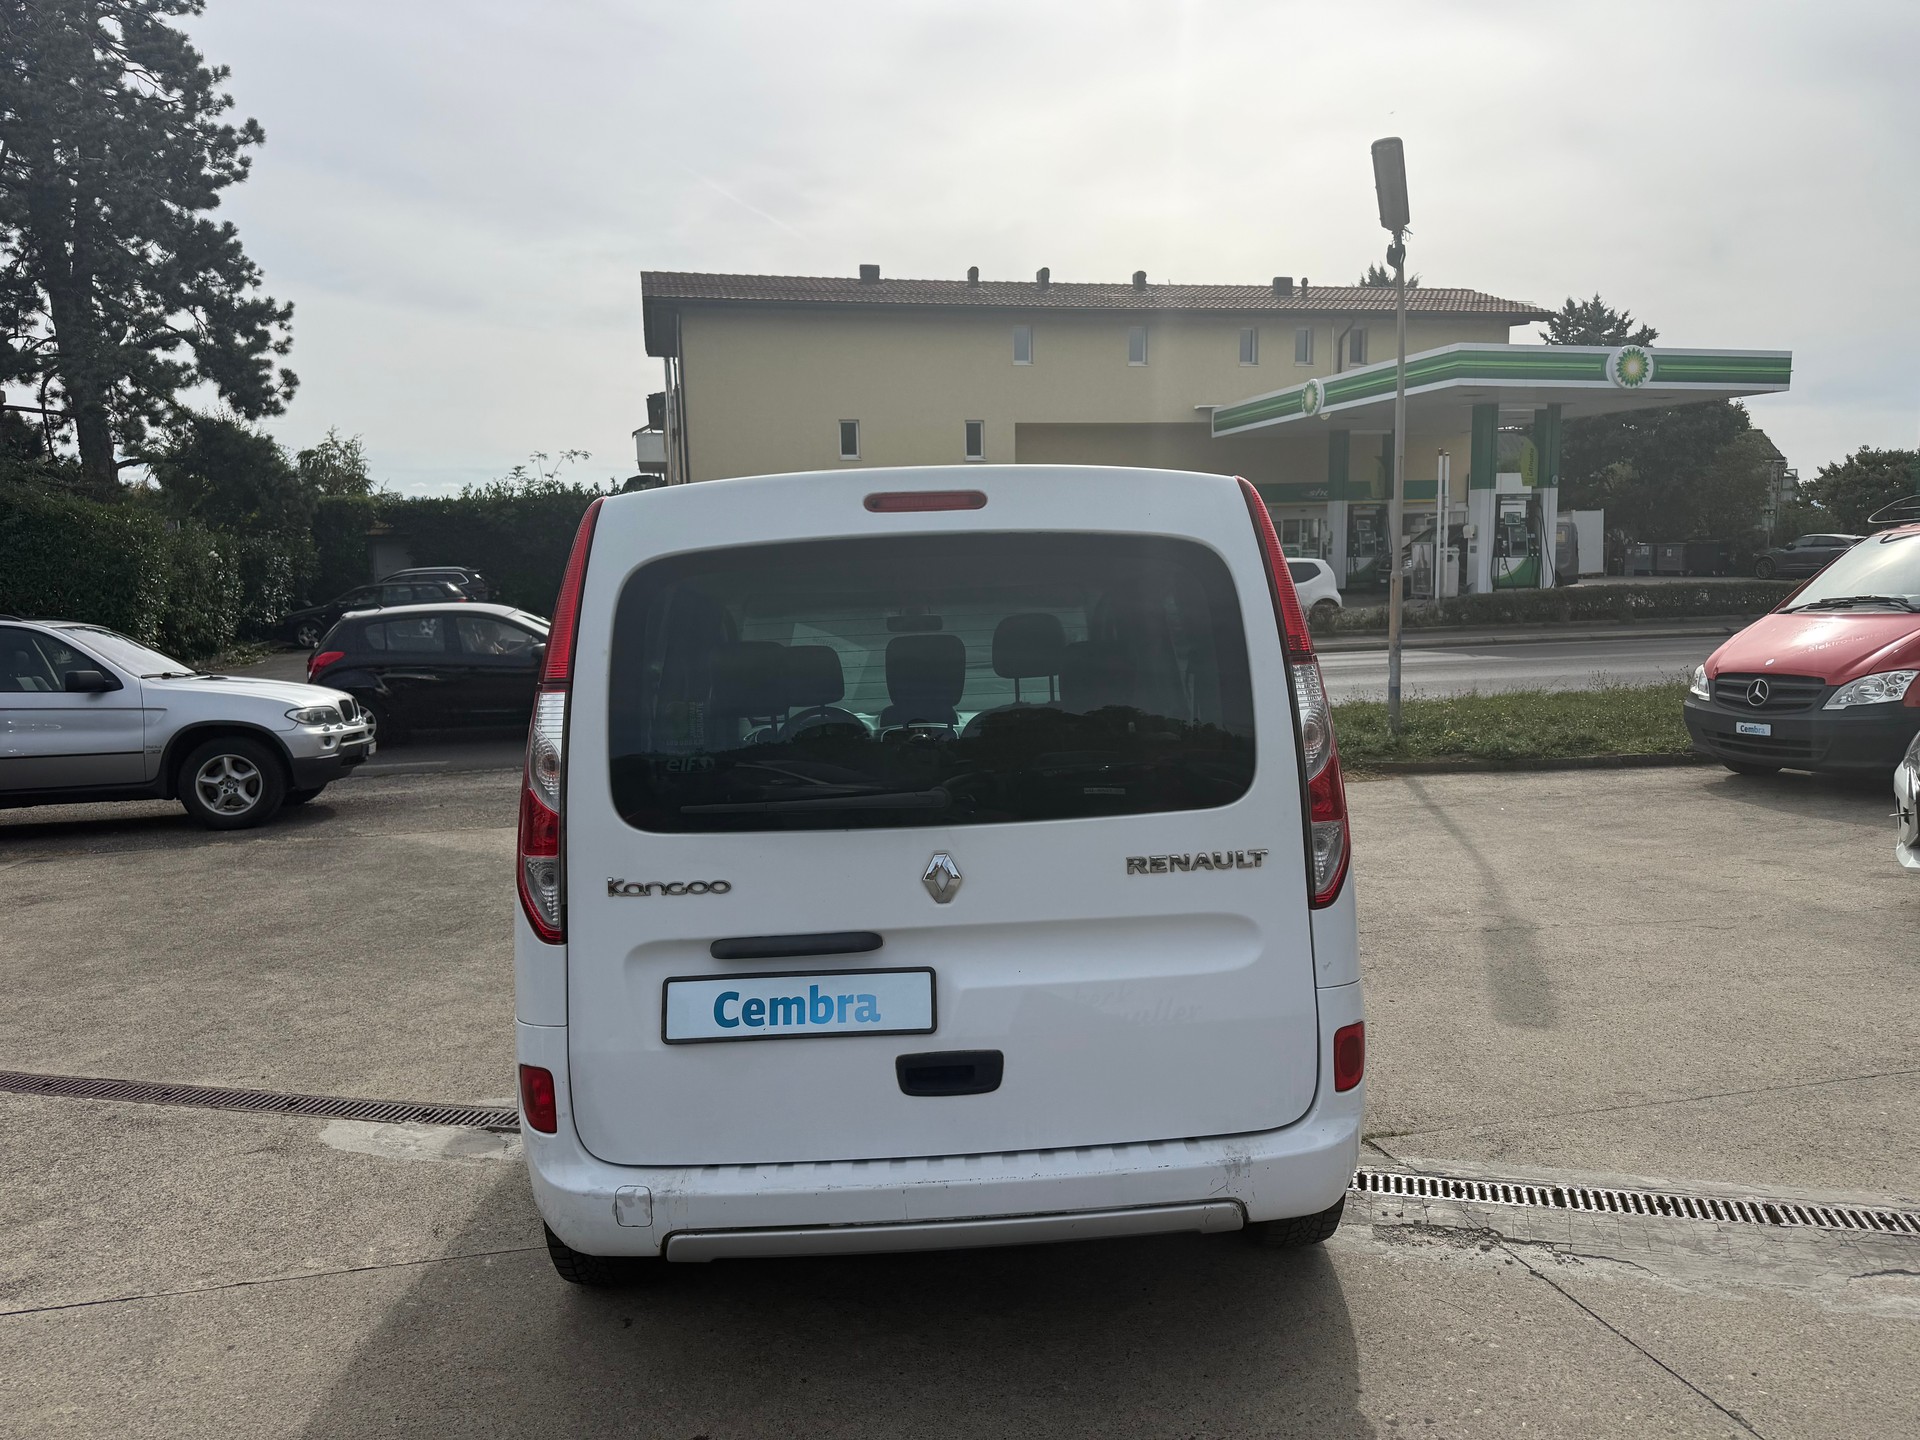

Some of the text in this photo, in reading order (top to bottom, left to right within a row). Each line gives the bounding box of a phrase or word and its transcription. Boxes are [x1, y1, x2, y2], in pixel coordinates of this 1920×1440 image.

[1740, 724, 1766, 734] Cembra
[1126, 849, 1269, 875] RENAULT
[713, 984, 881, 1028] Cembra
